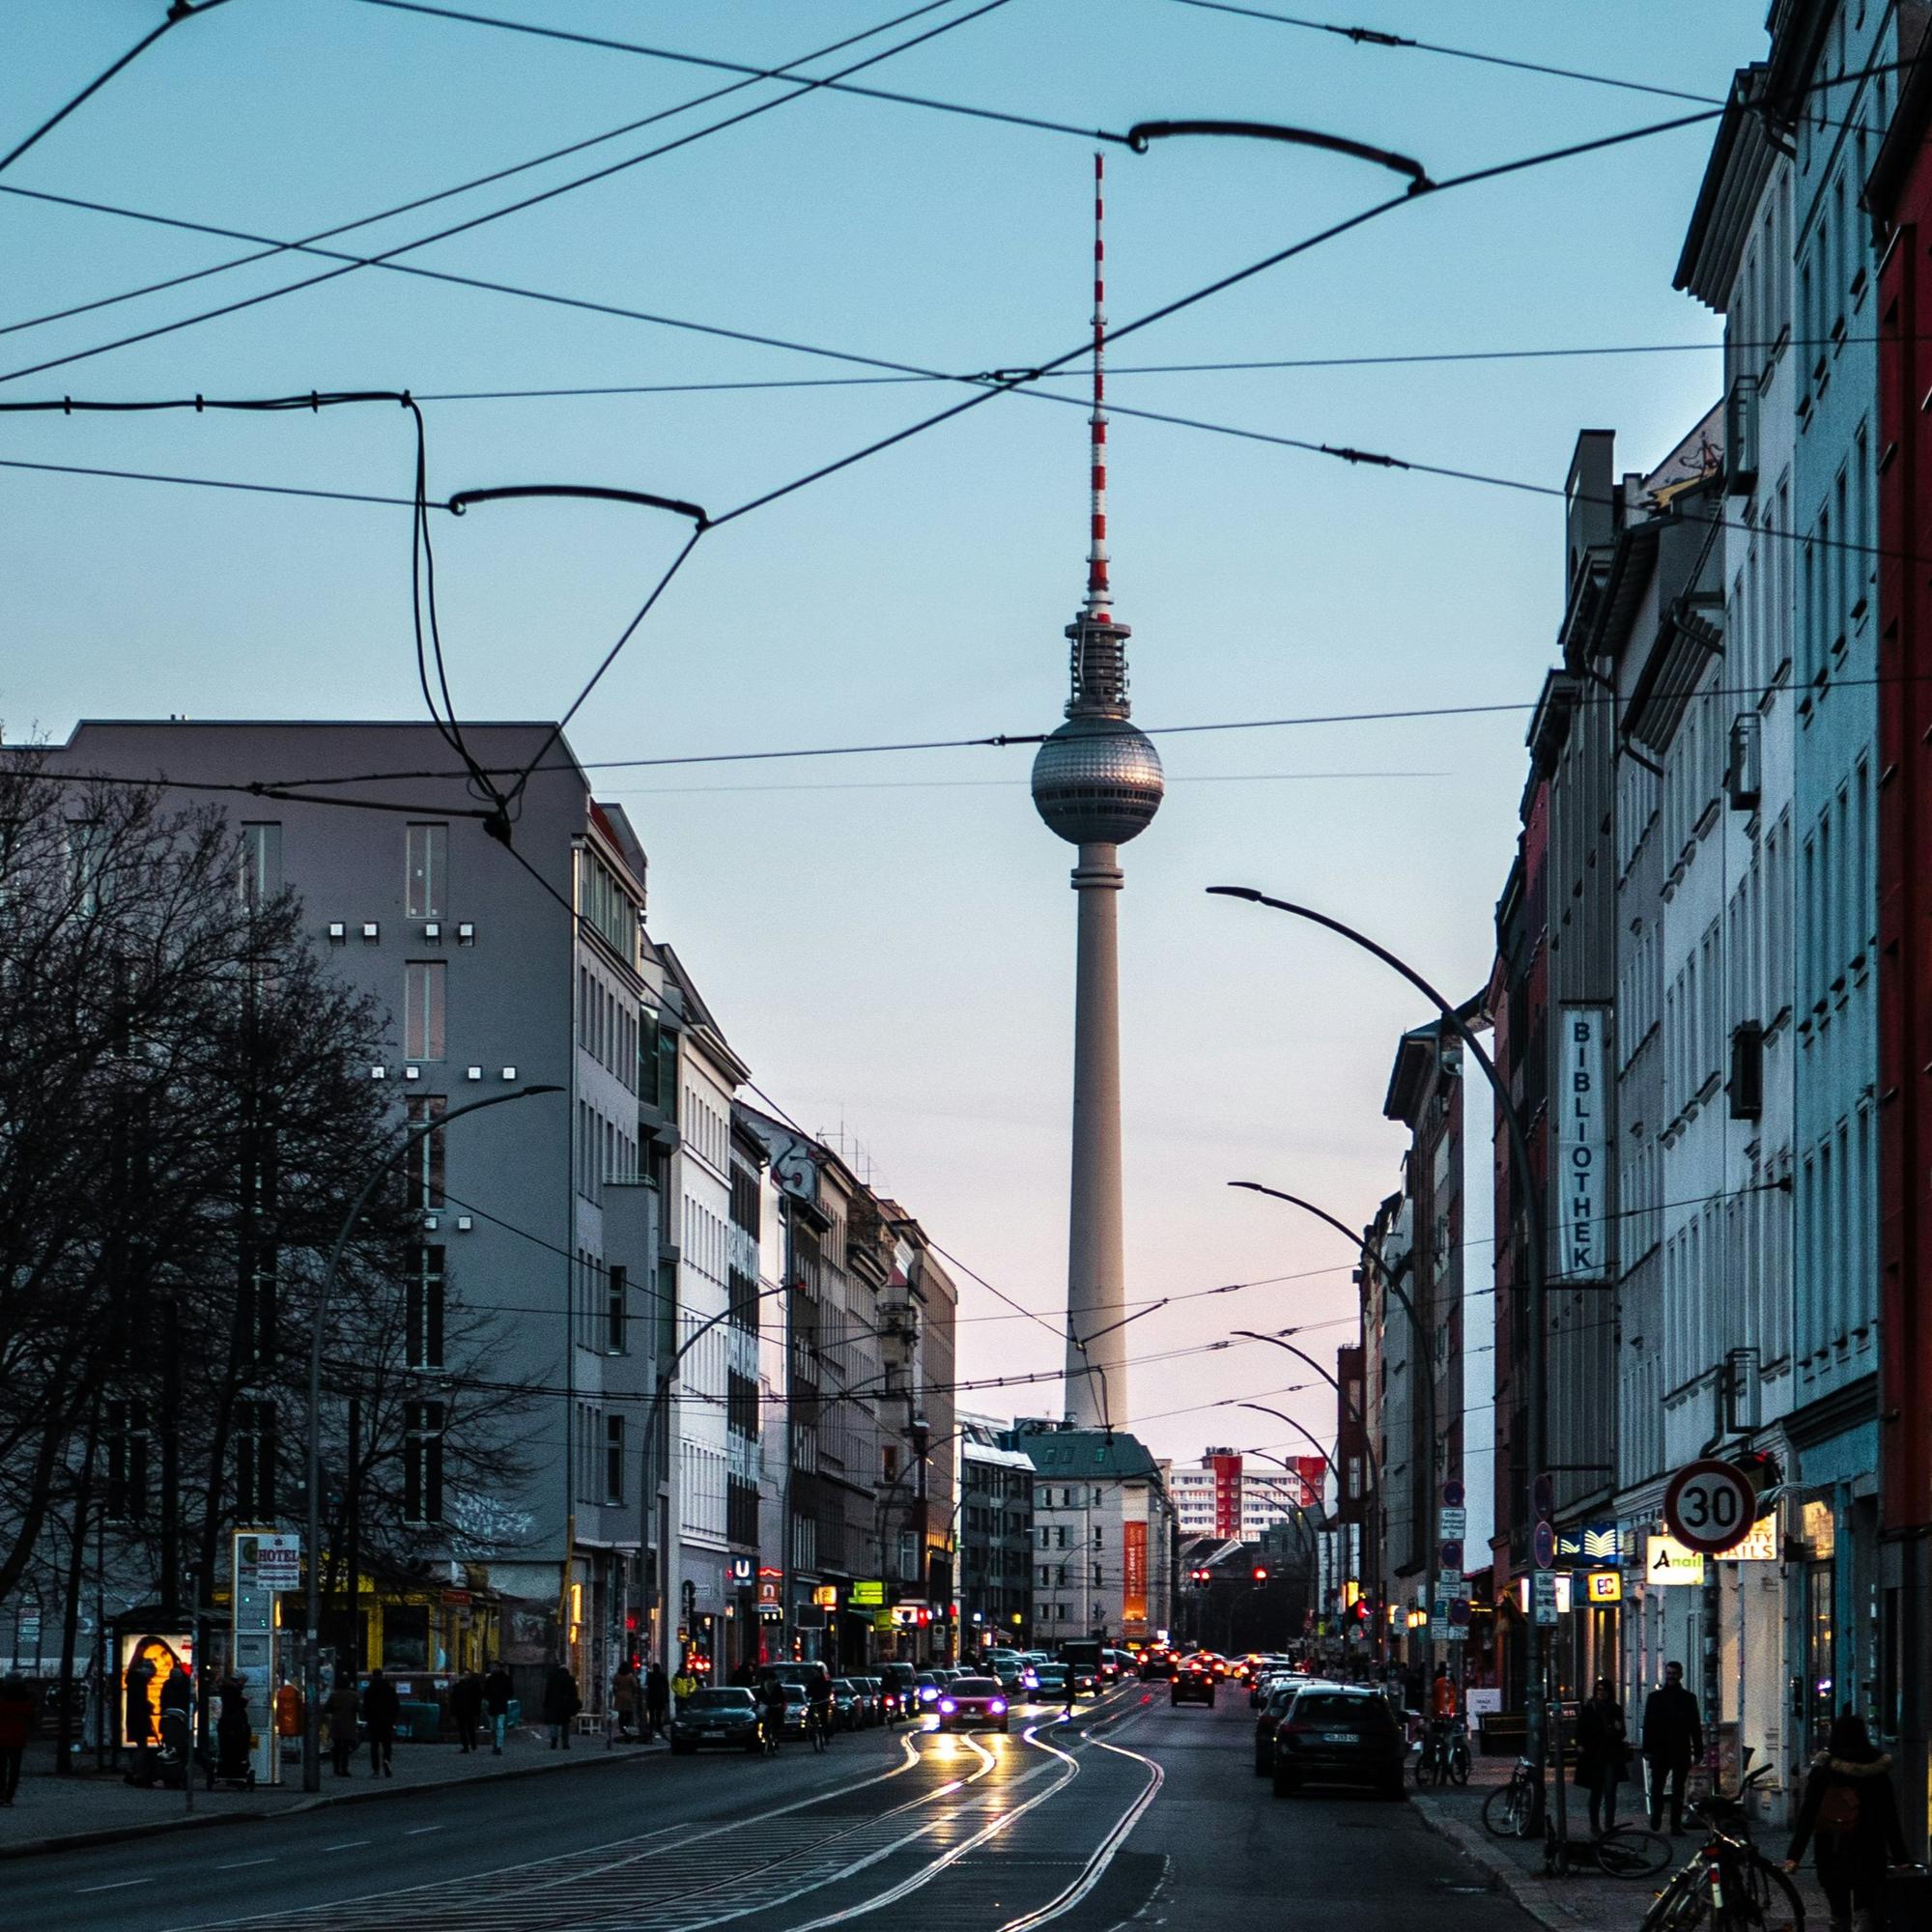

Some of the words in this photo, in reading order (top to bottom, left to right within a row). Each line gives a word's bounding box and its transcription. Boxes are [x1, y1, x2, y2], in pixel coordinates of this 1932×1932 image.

[1572, 1022, 1592, 1268] BIBLIOTHEK
[1684, 1486, 1736, 1527] 30
[258, 1549, 298, 1562] HOTEL
[735, 1560, 750, 1577] U
